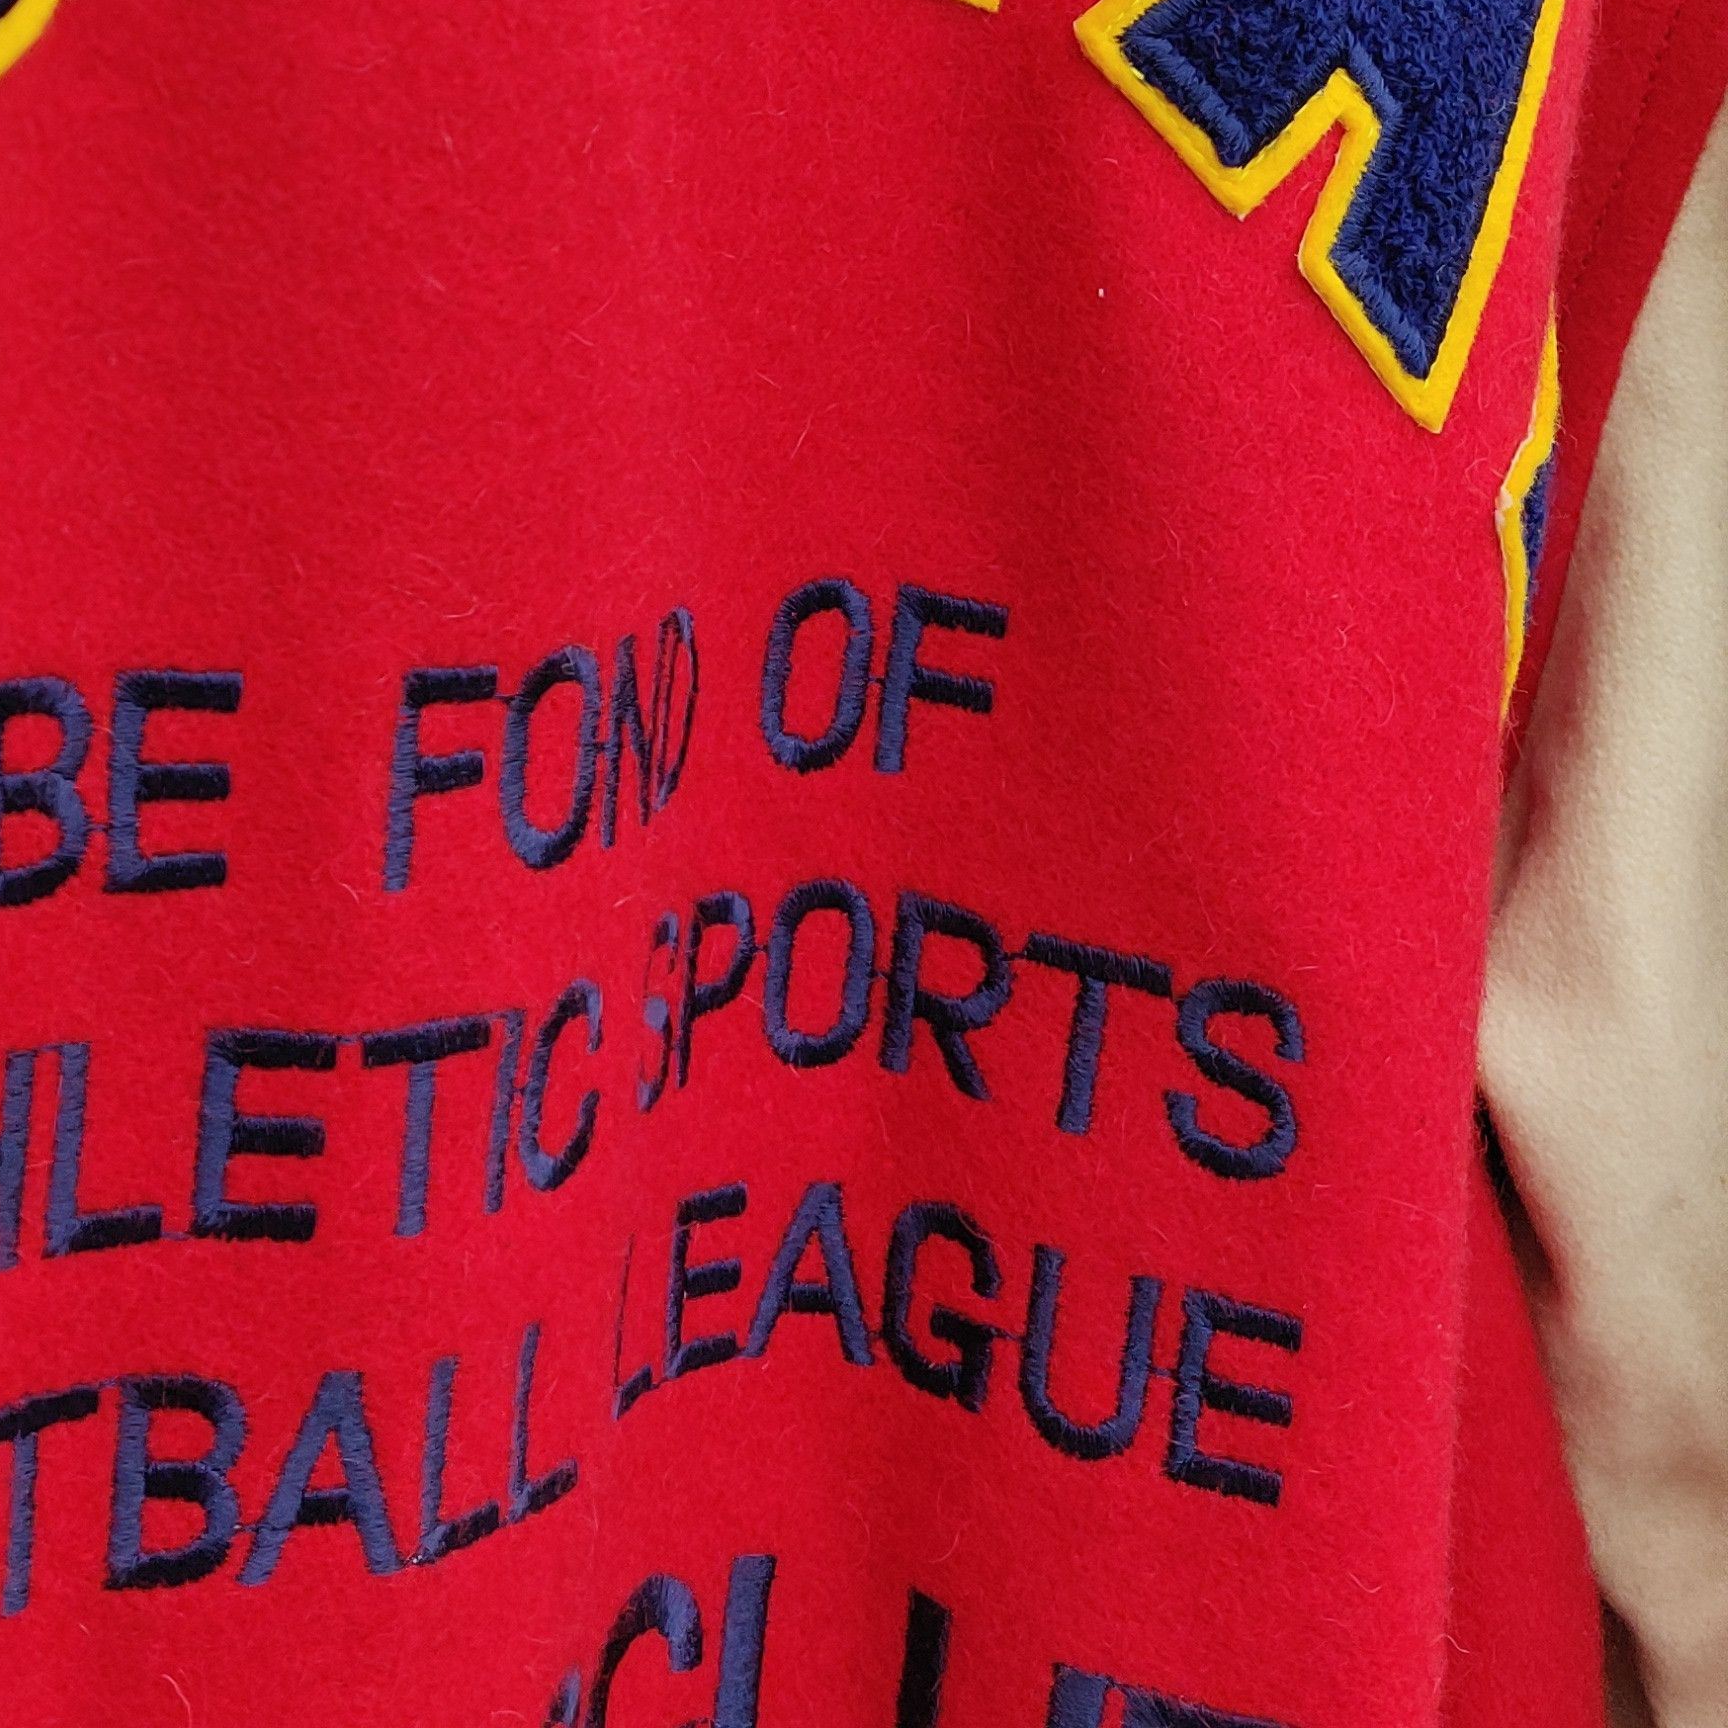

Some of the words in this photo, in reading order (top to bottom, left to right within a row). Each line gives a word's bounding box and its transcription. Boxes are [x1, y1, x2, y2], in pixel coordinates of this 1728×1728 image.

[382, 604, 700, 892] FOND
[758, 576, 1011, 776] OF
[635, 877, 1306, 1182] SPORTS
[610, 1180, 1304, 1509] LEAGUE
